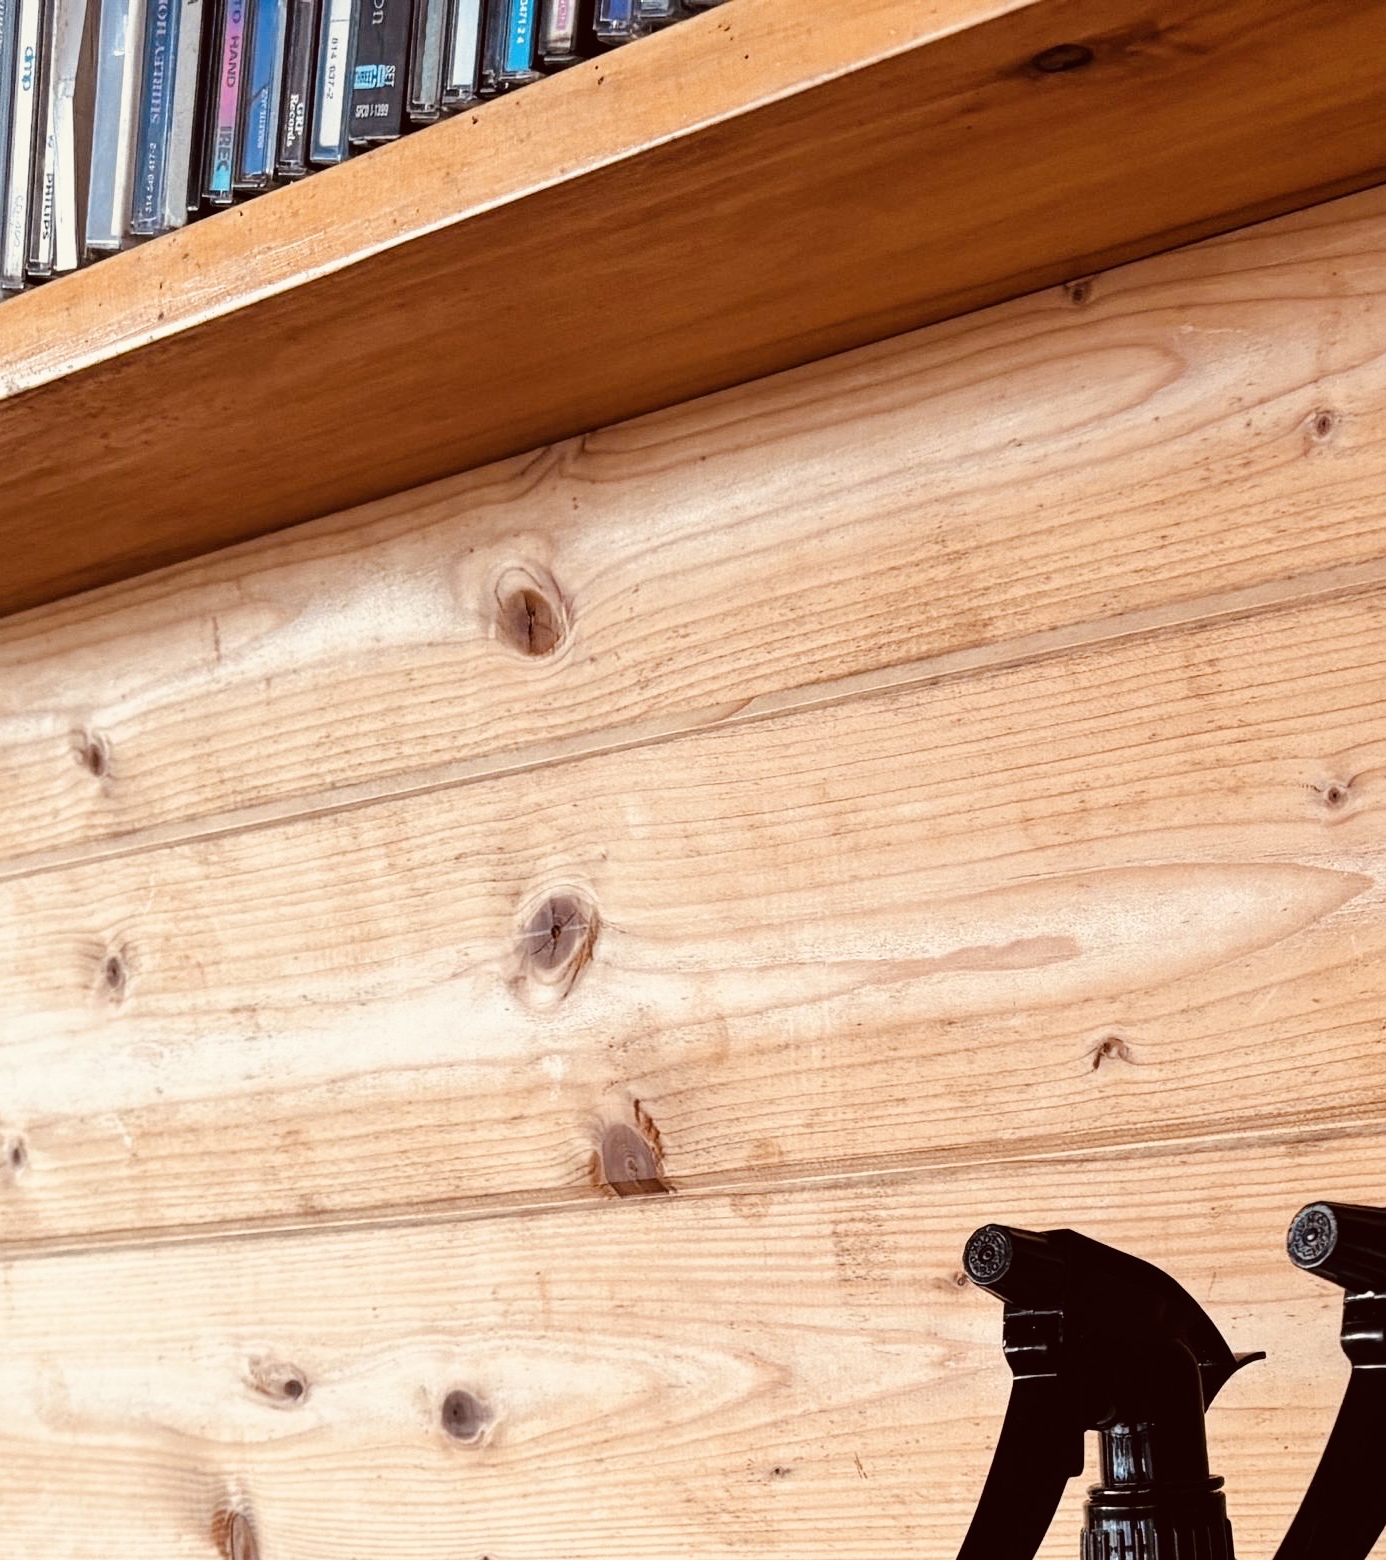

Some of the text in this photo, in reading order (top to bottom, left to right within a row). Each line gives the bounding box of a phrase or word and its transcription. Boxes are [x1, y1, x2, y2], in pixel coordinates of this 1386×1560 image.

[149, 43, 166, 125] SHIRLEY
[226, 36, 240, 88] HAND
[385, 65, 396, 88] SET
[286, 93, 300, 148] Records
[295, 102, 305, 136] GRP
[42, 172, 54, 240] PHILIPS
